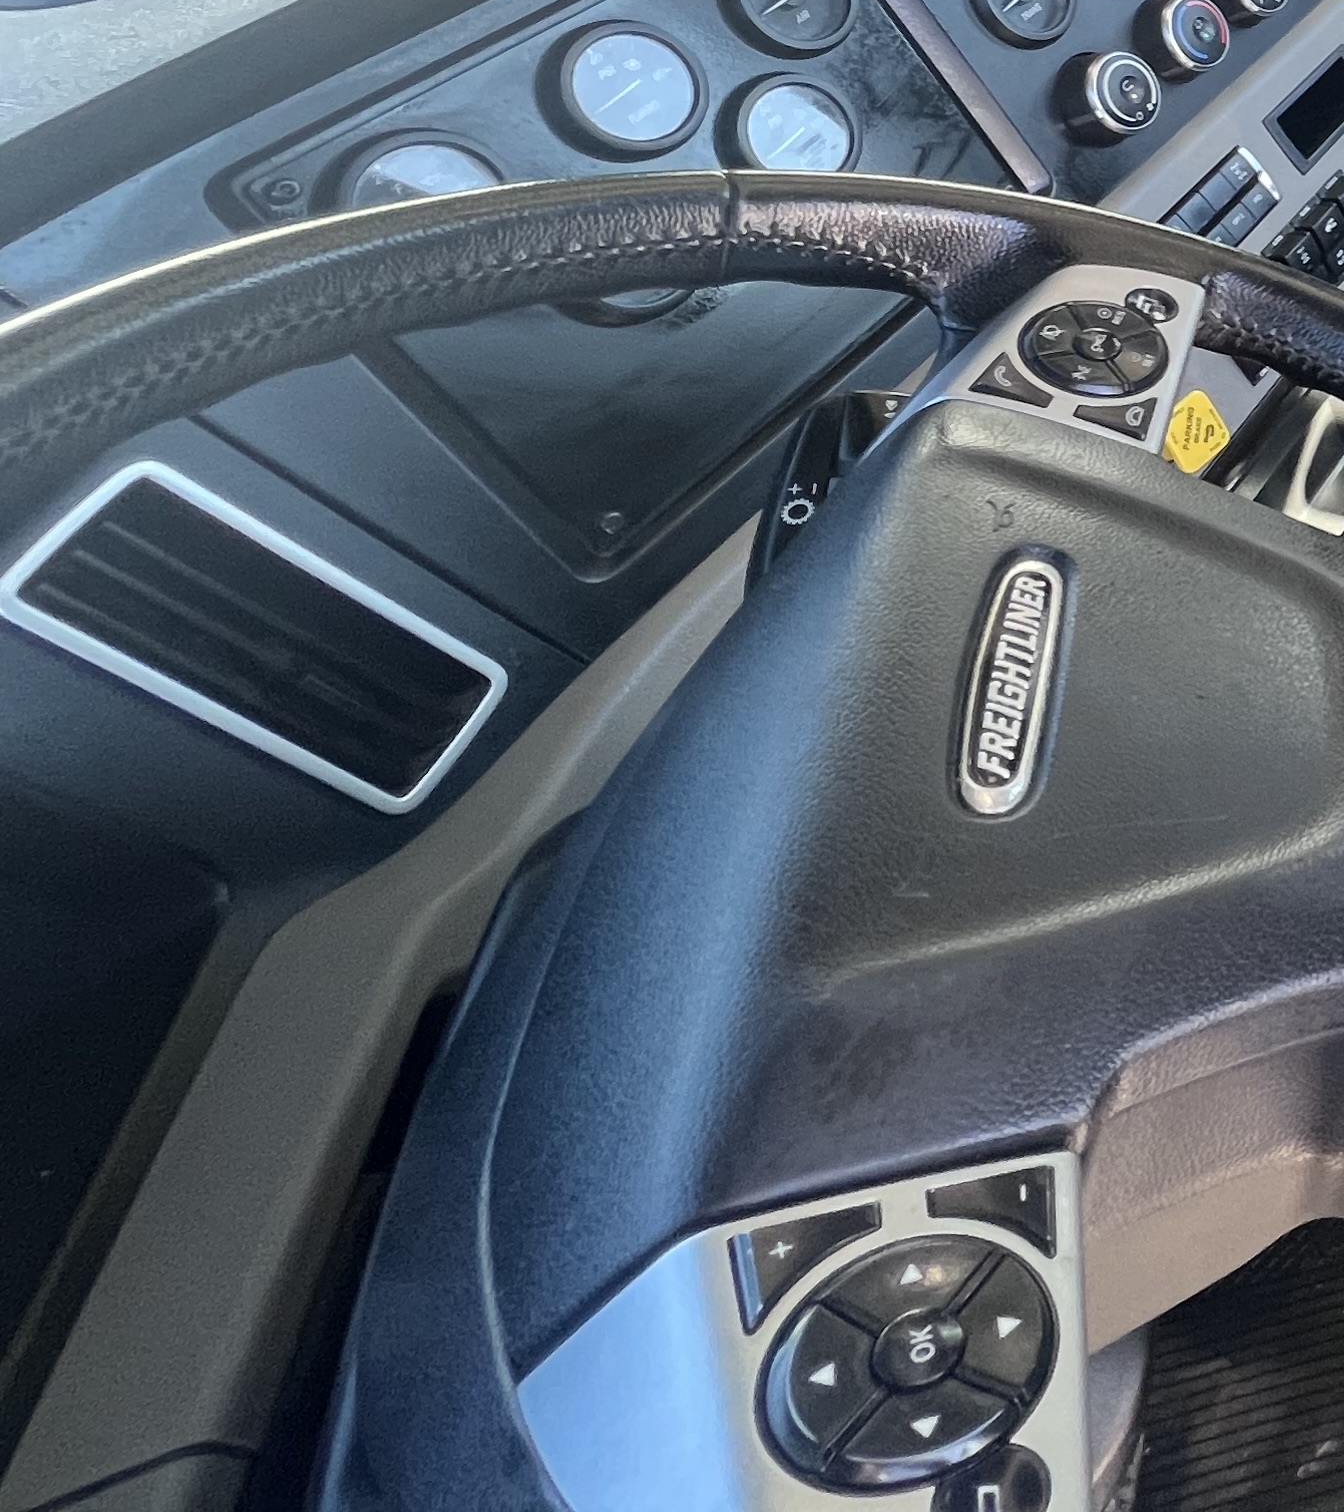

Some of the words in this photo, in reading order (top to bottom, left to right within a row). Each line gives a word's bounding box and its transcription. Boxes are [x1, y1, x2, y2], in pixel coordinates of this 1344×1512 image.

[1183, 407, 1194, 450] PARKING
[977, 575, 1047, 780] FREIGHTLINER
[909, 1324, 936, 1364] OK
